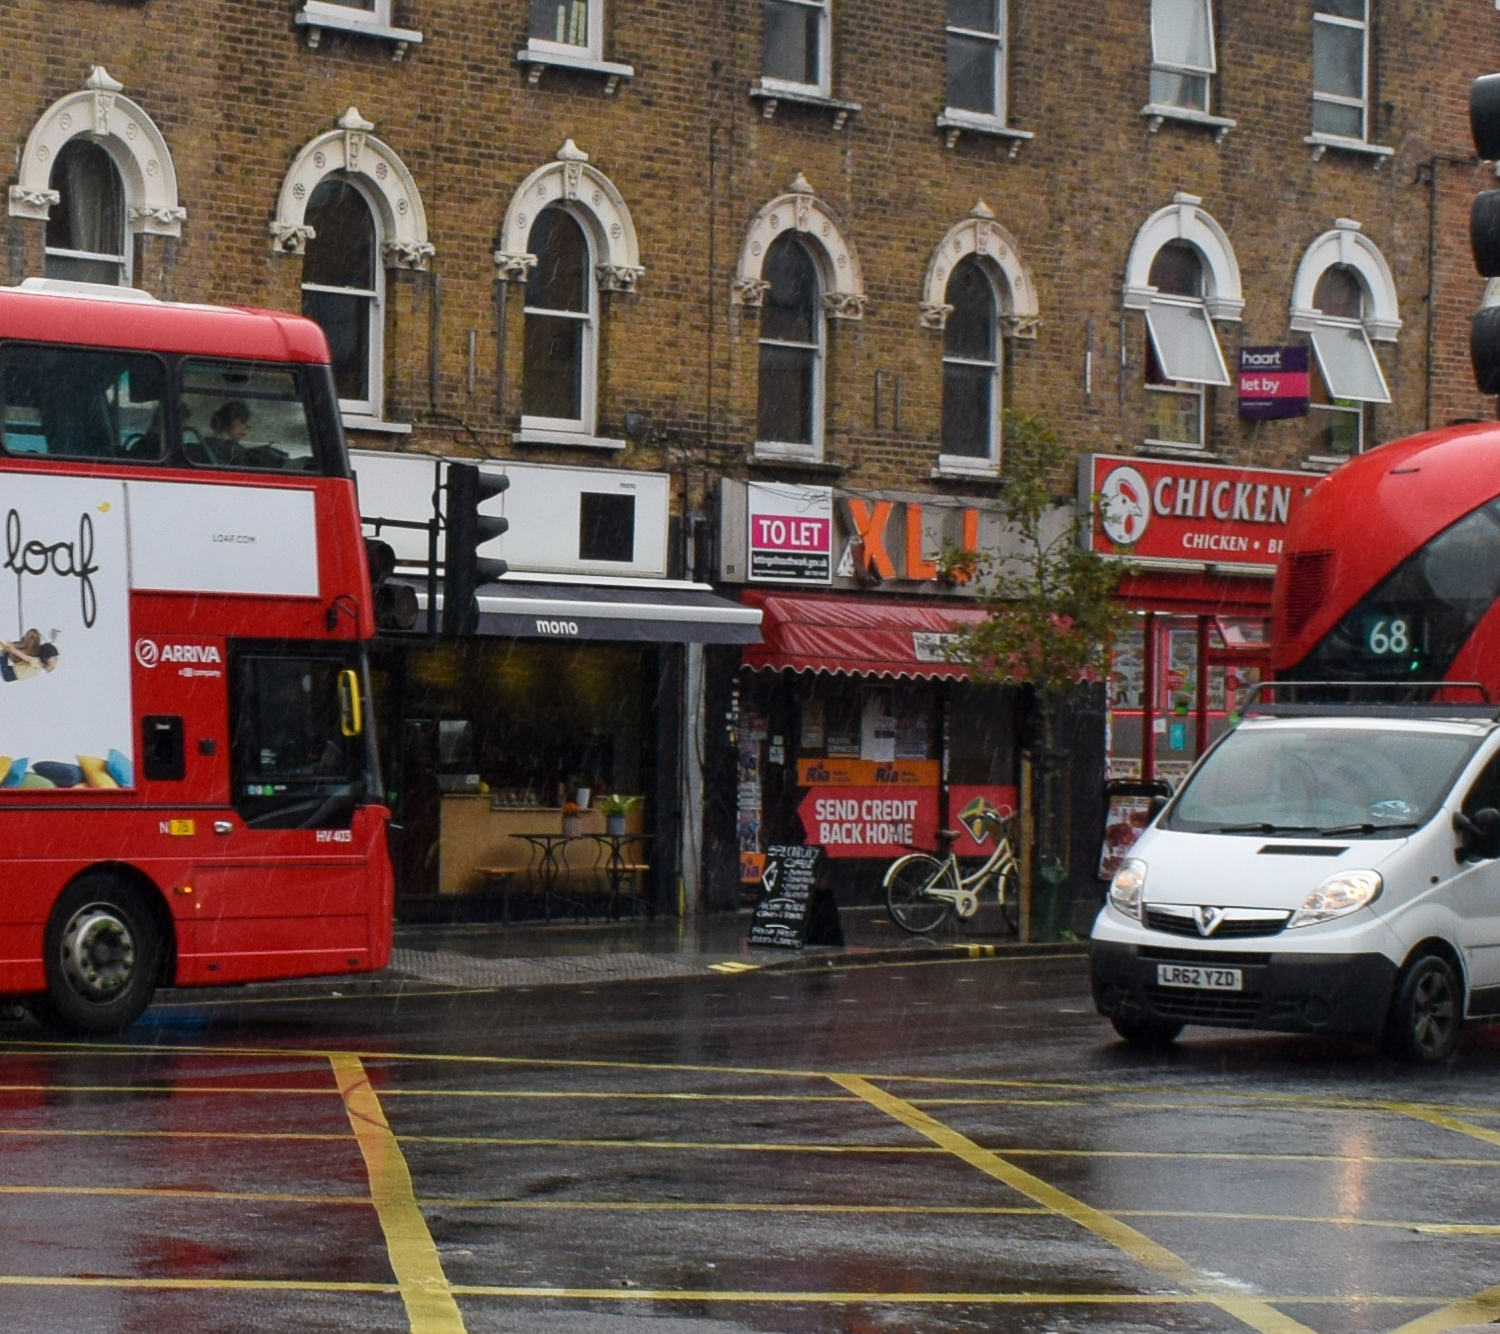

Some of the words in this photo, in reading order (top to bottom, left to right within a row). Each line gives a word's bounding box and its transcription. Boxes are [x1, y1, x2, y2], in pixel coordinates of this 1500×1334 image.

[1242, 351, 1281, 364] haart
[1241, 378, 1260, 390] let
[1262, 378, 1279, 394] by
[1153, 476, 1291, 524] CHICKEN
[212, 534, 255, 545] LOAF.COM
[759, 520, 786, 544] TO
[791, 523, 822, 546] LET
[1182, 532, 1248, 551] CHICKEN
[3, 508, 99, 629] loaf
[536, 620, 579, 635] mono
[1370, 619, 1408, 654] 68
[161, 644, 221, 663] ARRIVA
[815, 799, 859, 820] SEND
[862, 800, 918, 820] CREDIT
[819, 823, 862, 844] BACK
[866, 823, 913, 844] HOME
[1163, 968, 1200, 984] LR62
[1204, 970, 1234, 986] YZD
